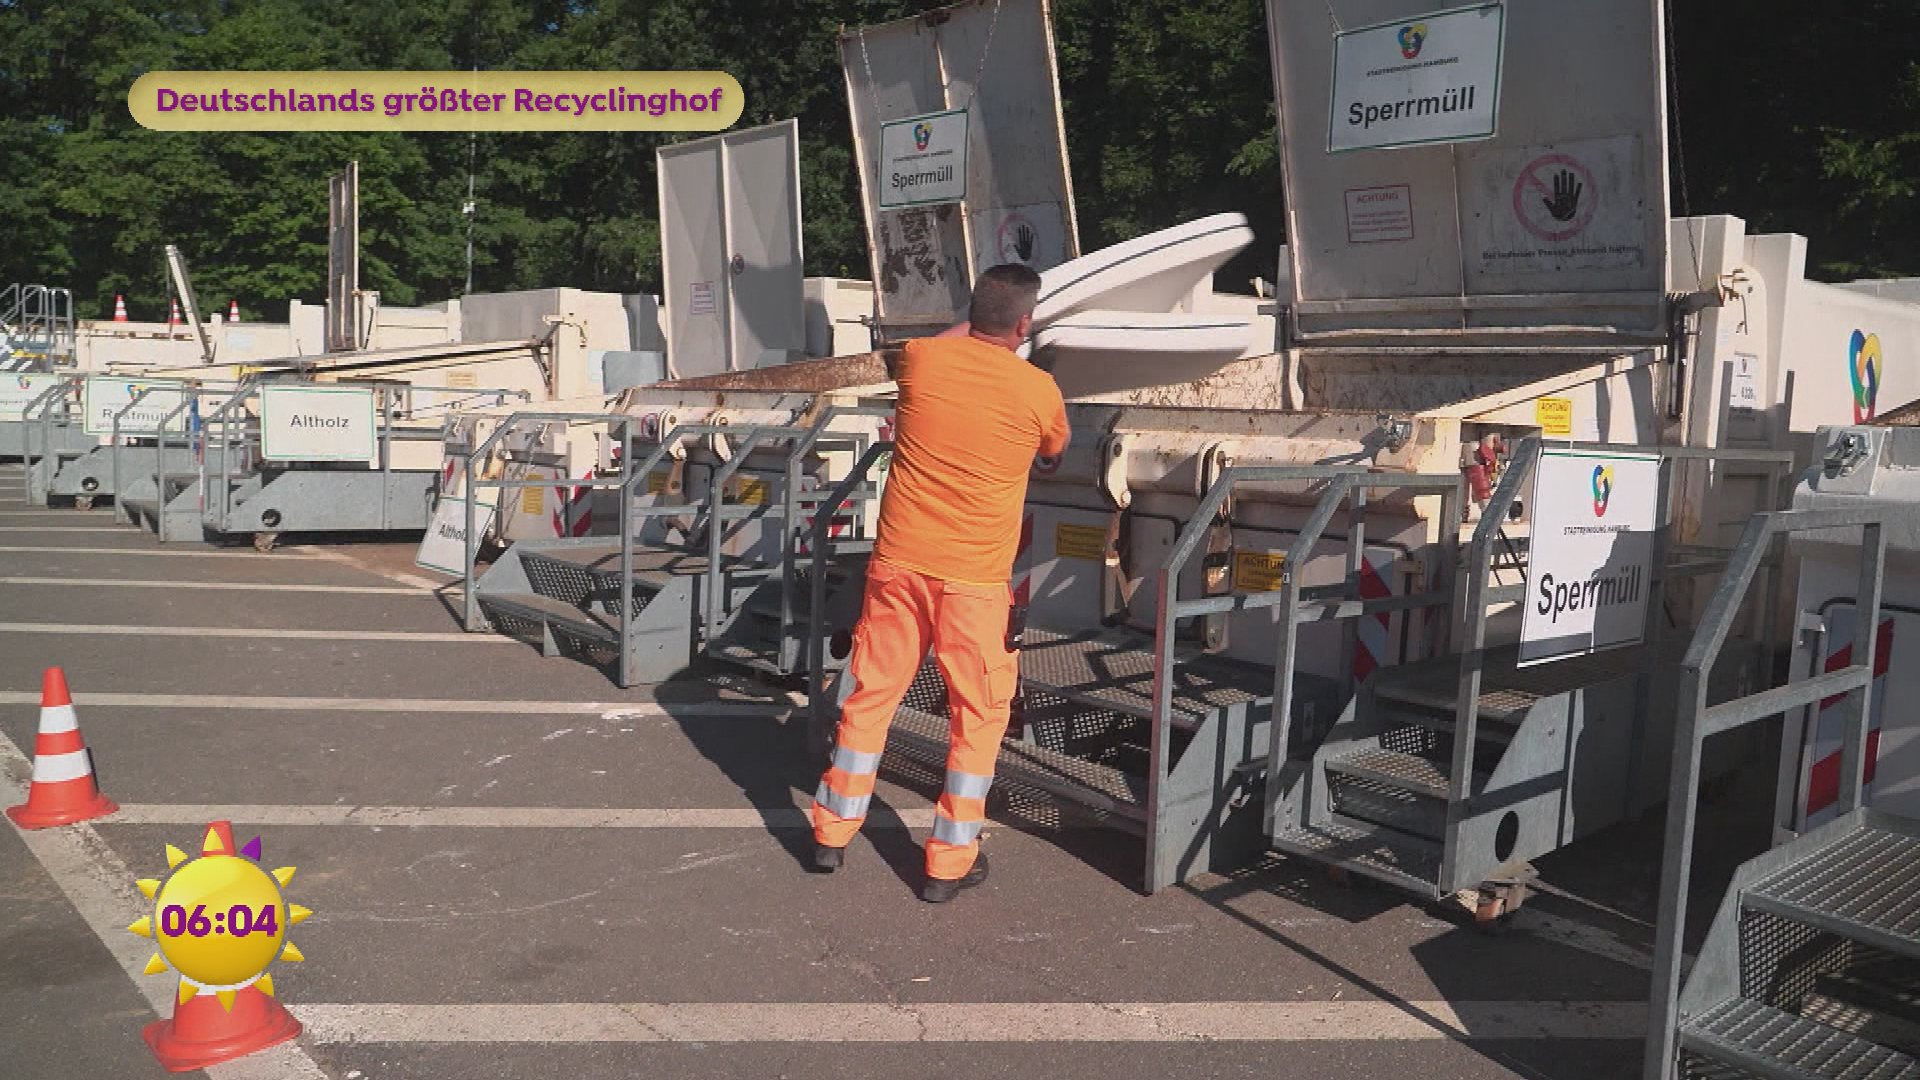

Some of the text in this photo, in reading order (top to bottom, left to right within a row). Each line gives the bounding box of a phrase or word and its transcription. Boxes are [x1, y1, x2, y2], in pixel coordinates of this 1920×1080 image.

[1348, 85, 1475, 129] Sperrmüll
[891, 164, 953, 192] Sperrmüll
[290, 414, 350, 428] Altholz
[1243, 556, 1285, 570] ACHTUN
[1537, 564, 1641, 624] Sperrmüll
